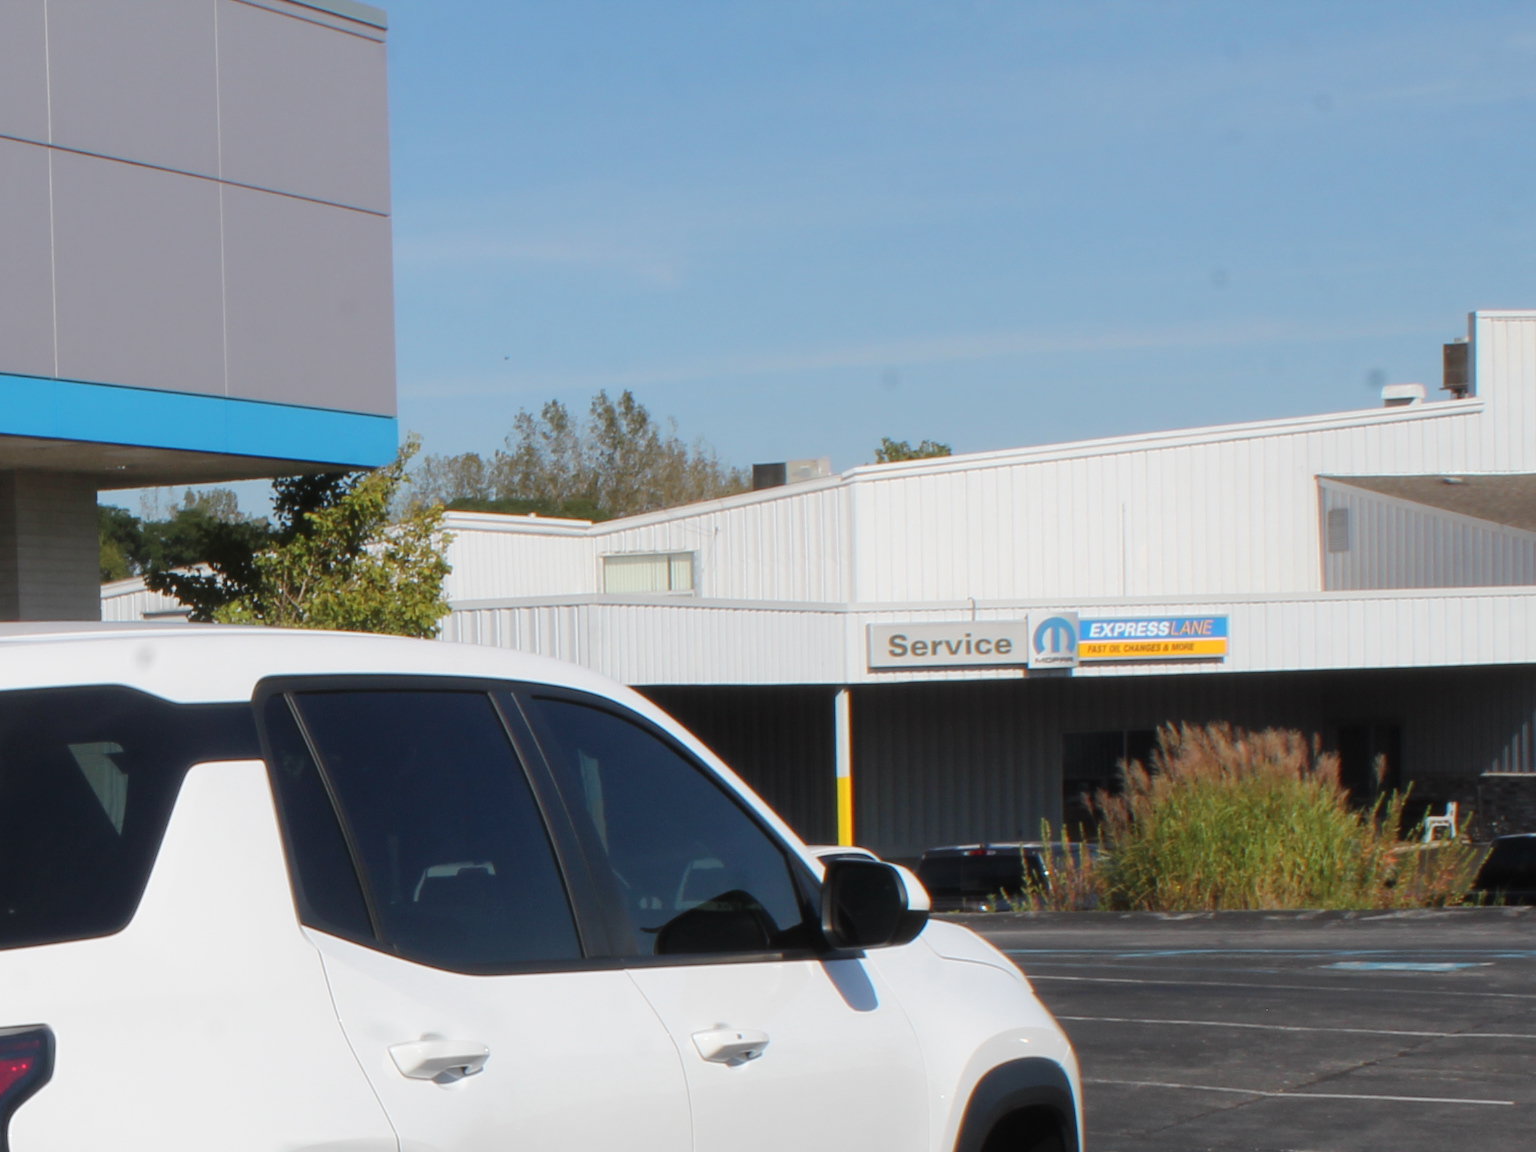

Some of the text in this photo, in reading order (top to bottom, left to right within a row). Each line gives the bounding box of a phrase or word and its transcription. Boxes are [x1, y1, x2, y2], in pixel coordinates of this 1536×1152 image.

[888, 632, 1013, 657] Service
[1087, 645, 1106, 654] FAST
[1123, 642, 1161, 653] CHANGES
[1171, 642, 1195, 651] MORE
